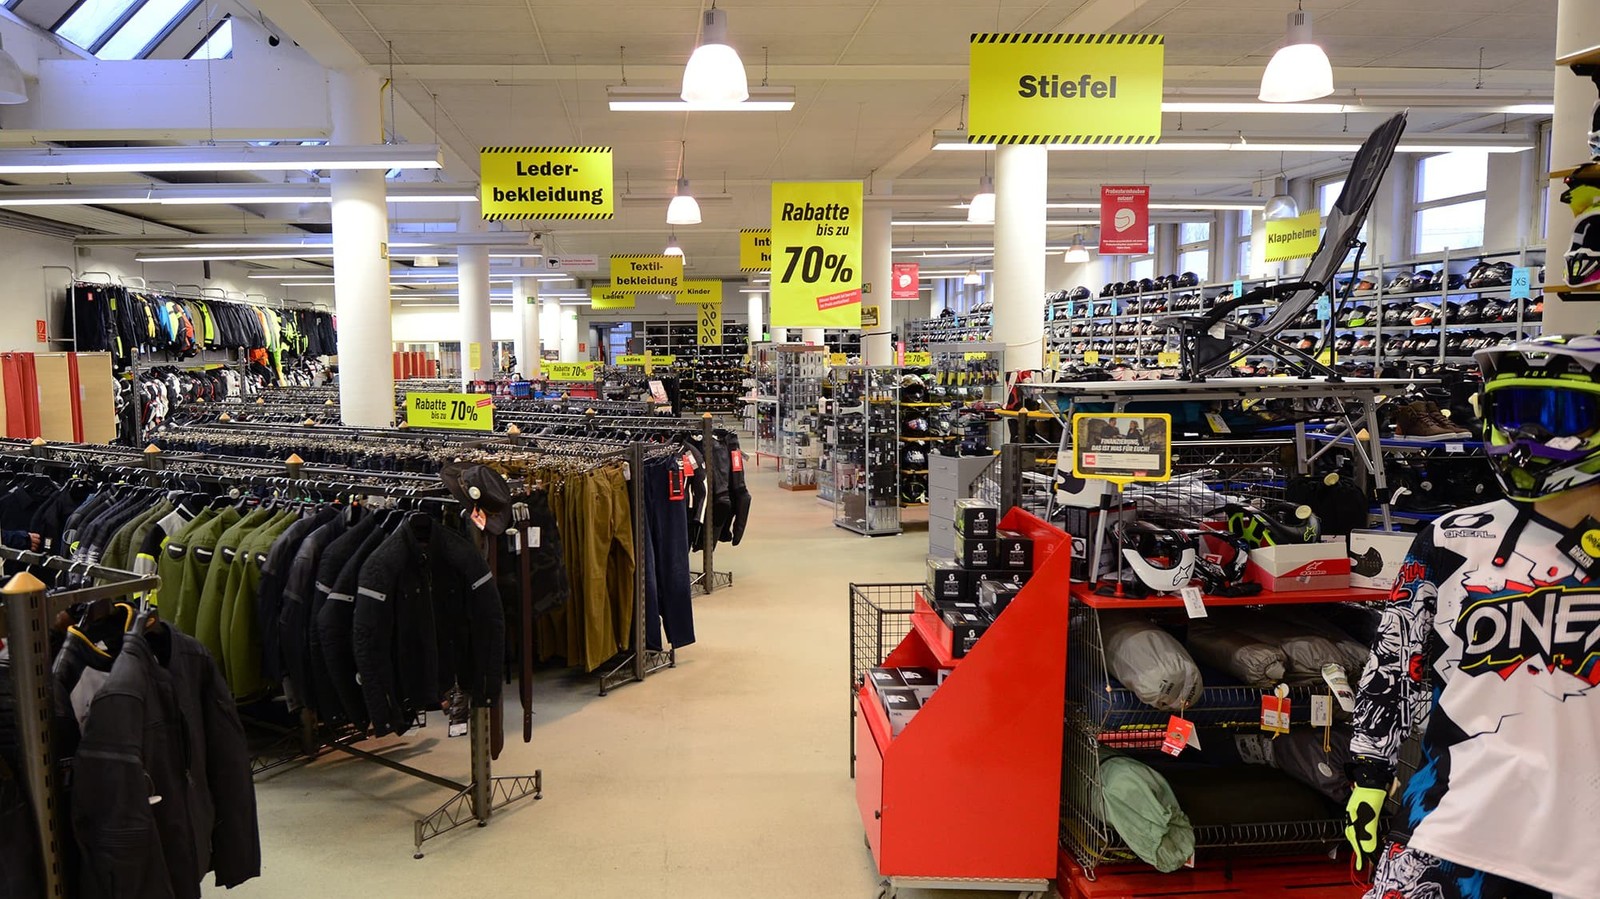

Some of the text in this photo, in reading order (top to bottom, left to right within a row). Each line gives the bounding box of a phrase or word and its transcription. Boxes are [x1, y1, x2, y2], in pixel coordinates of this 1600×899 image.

[1018, 75, 1117, 98] Stiefel
[516, 161, 578, 176] Leder-
[493, 187, 603, 205] bekleidung
[781, 203, 849, 221] Rabatte
[816, 224, 849, 236] bis zu
[1268, 228, 1317, 244] Klapphelme
[754, 237, 771, 246] Int
[630, 262, 663, 271] Textil-
[780, 246, 853, 283] 70%
[617, 276, 678, 286] bekleidung
[1514, 278, 1527, 287] XS
[572, 366, 586, 376] 70%
[416, 398, 446, 410] Rabatte
[450, 401, 478, 420] 70%
[1122, 444, 1133, 452] FÜR
